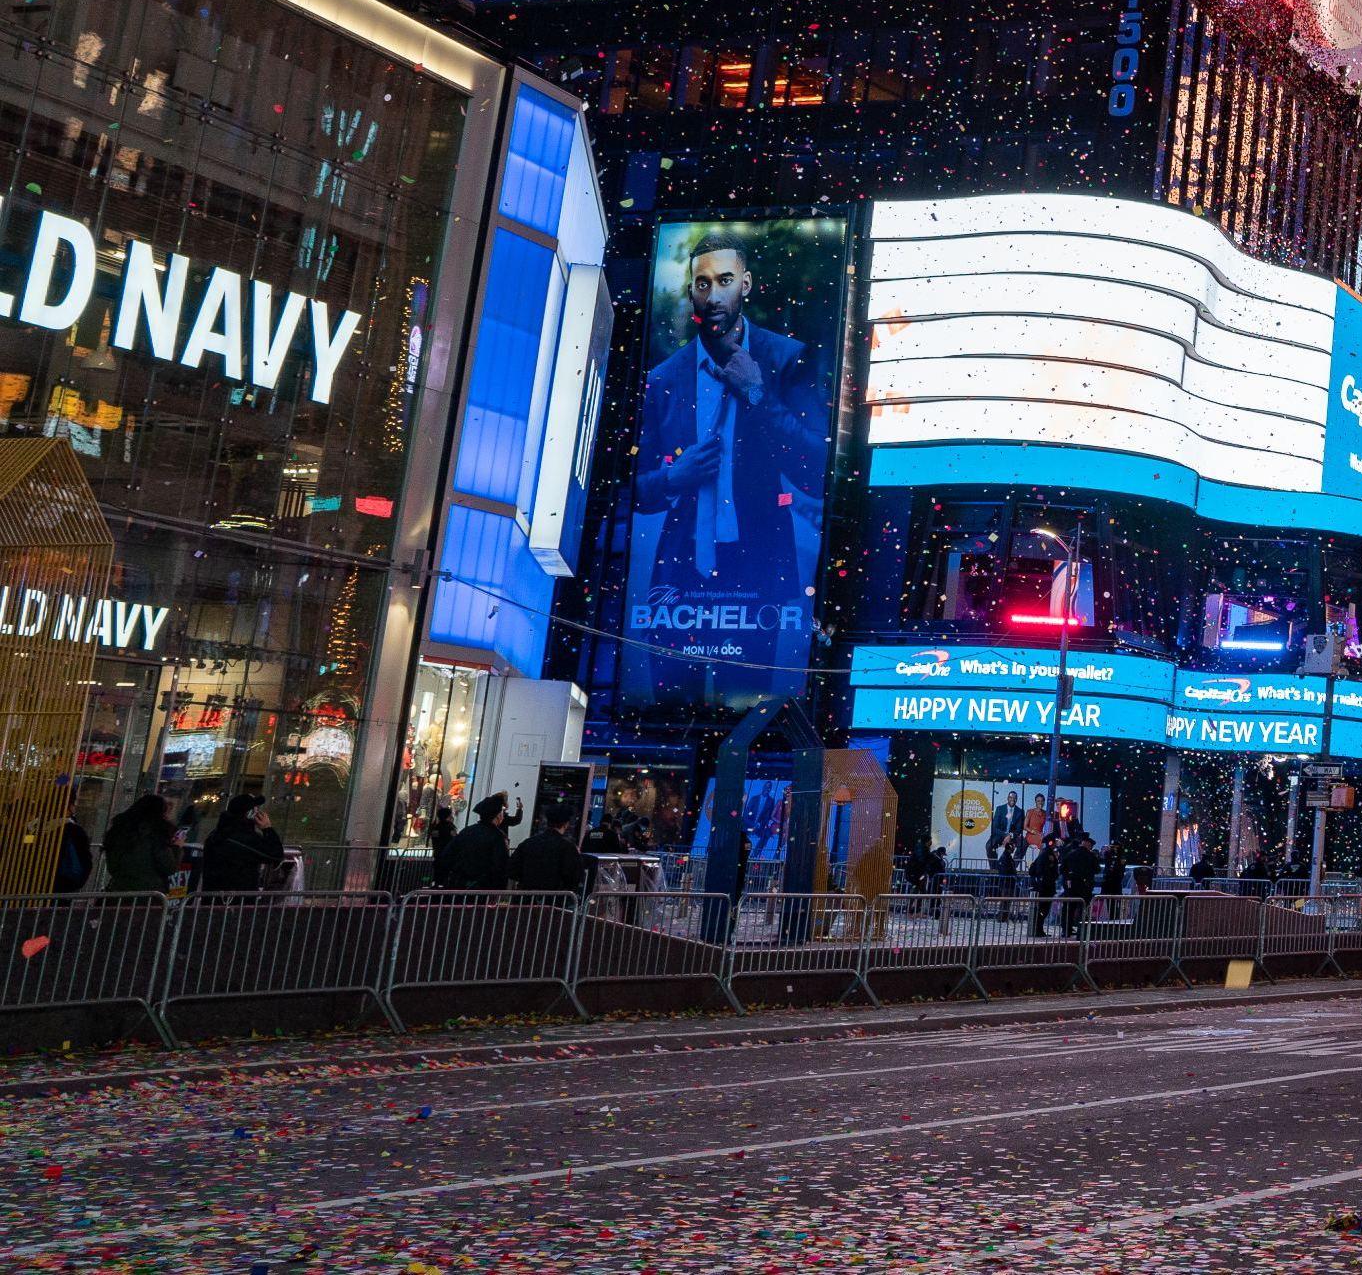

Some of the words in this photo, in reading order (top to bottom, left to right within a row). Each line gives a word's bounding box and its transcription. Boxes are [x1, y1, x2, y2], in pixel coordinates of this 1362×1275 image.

[0, 199, 98, 332] D
[114, 240, 362, 406] NAVY
[647, 583, 681, 606] The
[52, 593, 170, 651] NAVY
[630, 604, 803, 631] BACHELOR
[683, 644, 704, 655] MON
[706, 644, 719, 655] 1/4
[721, 643, 743, 655] abc
[960, 659, 1009, 675] What's
[1012, 661, 1026, 676] in
[1065, 665, 1114, 682] wallet?
[1257, 686, 1301, 702] What's
[1303, 688, 1316, 702] in
[894, 696, 963, 722] HAPPY
[967, 698, 1030, 723] NEW
[1201, 719, 1255, 743] NEW
[1258, 721, 1319, 746] YEAR
[948, 809, 990, 820] AMERICA
